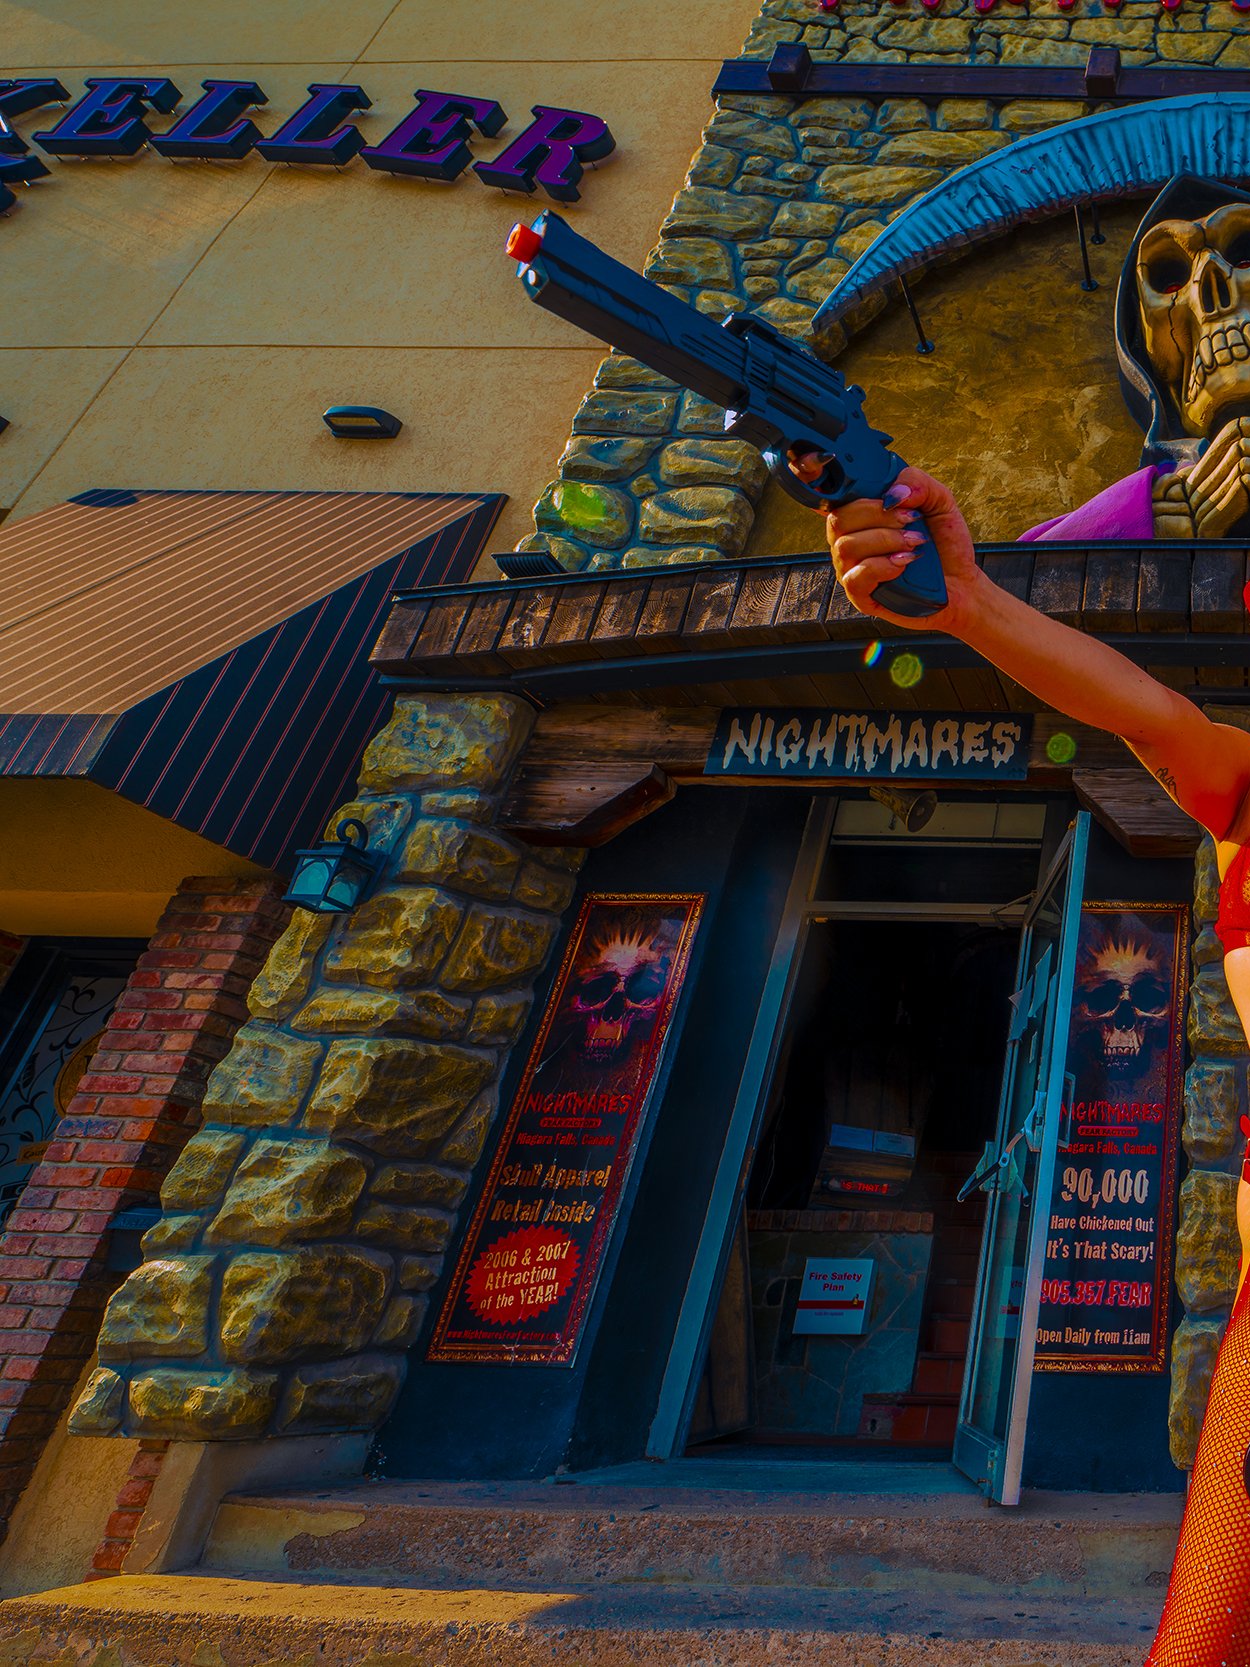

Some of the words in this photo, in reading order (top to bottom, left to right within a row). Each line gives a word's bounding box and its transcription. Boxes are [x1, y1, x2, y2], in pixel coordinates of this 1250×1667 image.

[722, 713, 1021, 773] NIGHTMARES
[523, 1091, 633, 1115] NIGHTMARES
[542, 1119, 563, 1127] FEAR
[564, 1119, 600, 1127] FACTORY
[516, 1132, 552, 1145] Niagara
[554, 1132, 577, 1146] Falls,
[581, 1133, 616, 1146] Canada
[1058, 1142, 1094, 1154] agara
[1097, 1141, 1120, 1156] Falls,
[1123, 1142, 1157, 1155] Canada
[501, 1163, 543, 1187] Skull
[541, 1164, 612, 1189] Apparel
[1061, 1167, 1149, 1209] 90,000
[491, 1200, 544, 1221] Retail
[543, 1200, 596, 1223] Inside
[1050, 1215, 1076, 1230] Have
[1079, 1215, 1132, 1231] Chickened
[1135, 1217, 1155, 1232] Out
[484, 1250, 517, 1269] 2006
[521, 1248, 531, 1266] &
[536, 1240, 571, 1262] 2007
[1046, 1238, 1070, 1259] It's
[1074, 1241, 1107, 1260] That
[1110, 1242, 1155, 1263] Scary!
[485, 1266, 557, 1291] Attraction
[809, 1272, 828, 1281] Fire
[831, 1272, 862, 1282] Safety
[823, 1283, 844, 1291] Plan
[480, 1296, 493, 1310] of
[496, 1293, 514, 1309] the
[520, 1282, 560, 1305] YEAR!
[1036, 1328, 1061, 1346] Open
[1064, 1327, 1091, 1346] Daily
[1094, 1329, 1120, 1344] from
